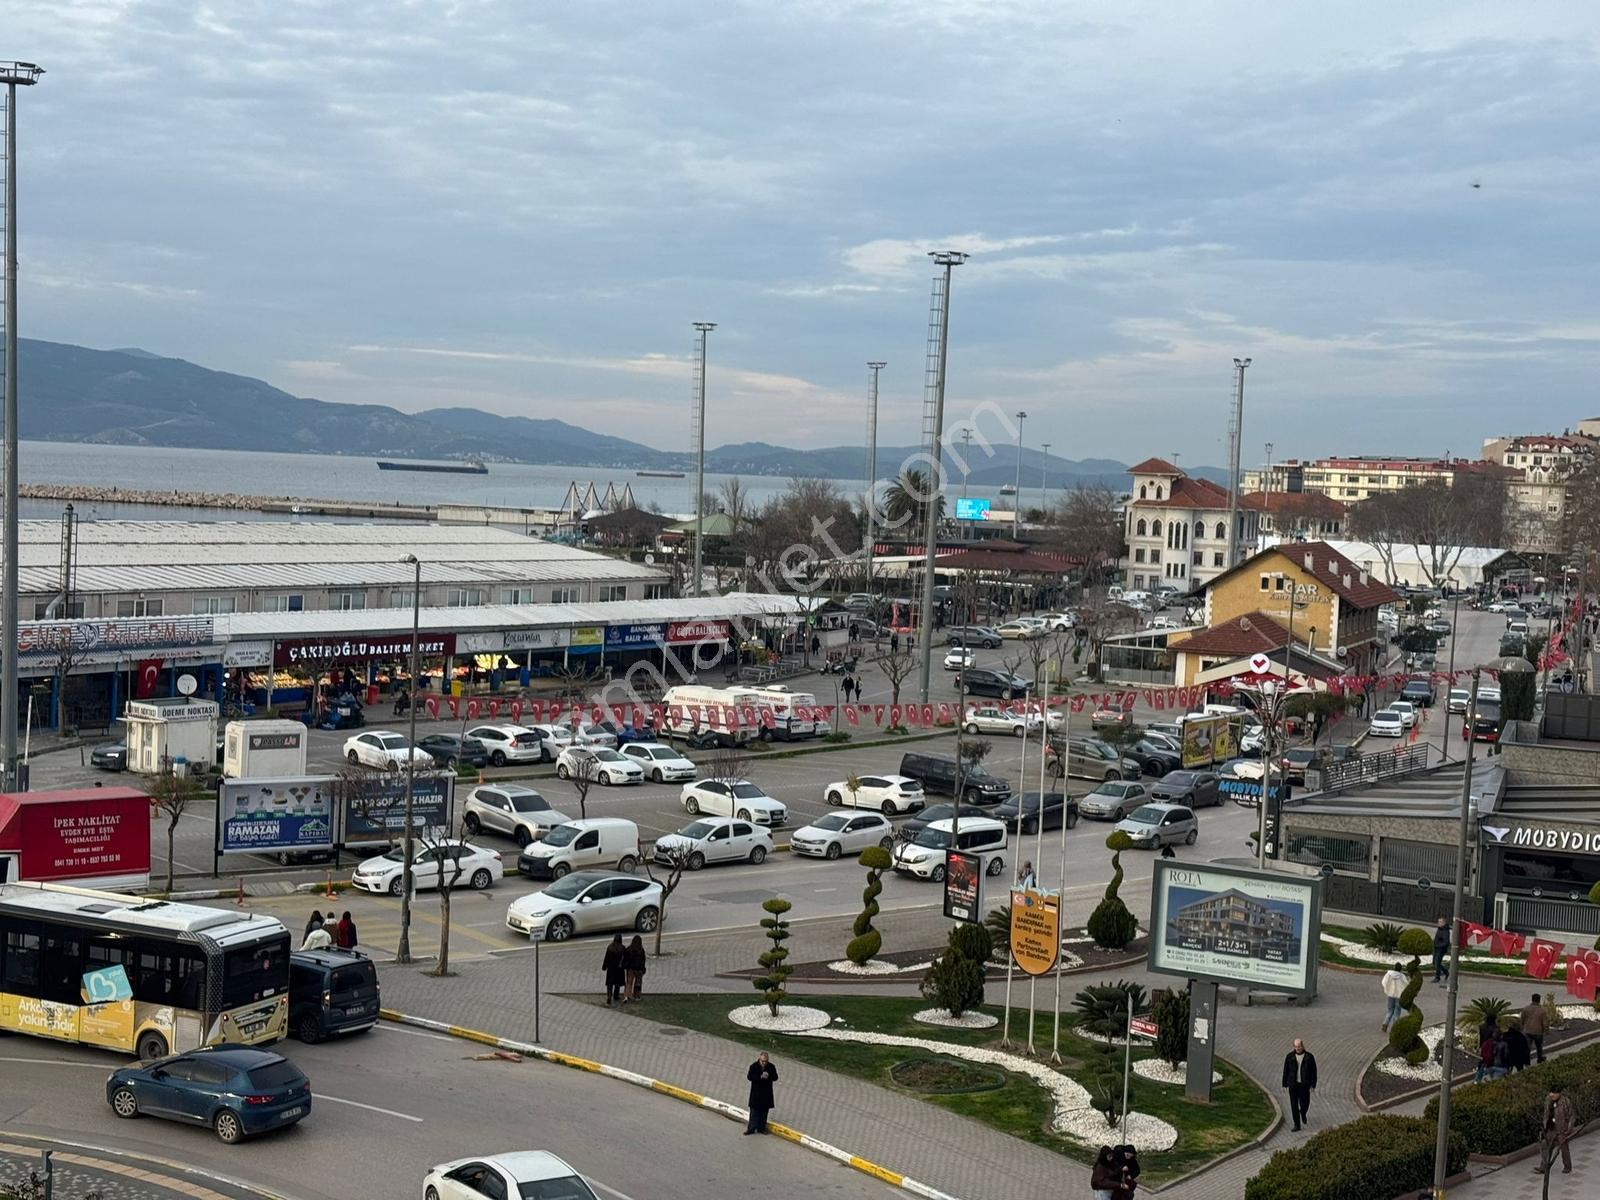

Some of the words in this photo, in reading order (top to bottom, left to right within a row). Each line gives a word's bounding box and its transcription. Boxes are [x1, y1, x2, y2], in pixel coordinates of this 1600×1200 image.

[289, 641, 367, 662] ÇAKIROĞLU
[369, 644, 401, 655] BALIK
[402, 642, 445, 653] MRKET
[162, 707, 185, 717] ÖDEME
[187, 706, 215, 716] NOKTASI
[1218, 780, 1278, 798] MOBYDIK
[419, 794, 443, 804] HAZIR
[1230, 793, 1250, 801] BALIK
[54, 817, 75, 828] İPEK
[78, 814, 120, 827] NAKLİYAT
[228, 825, 280, 836] RAMAZAN
[1169, 870, 1202, 885] ROTA
